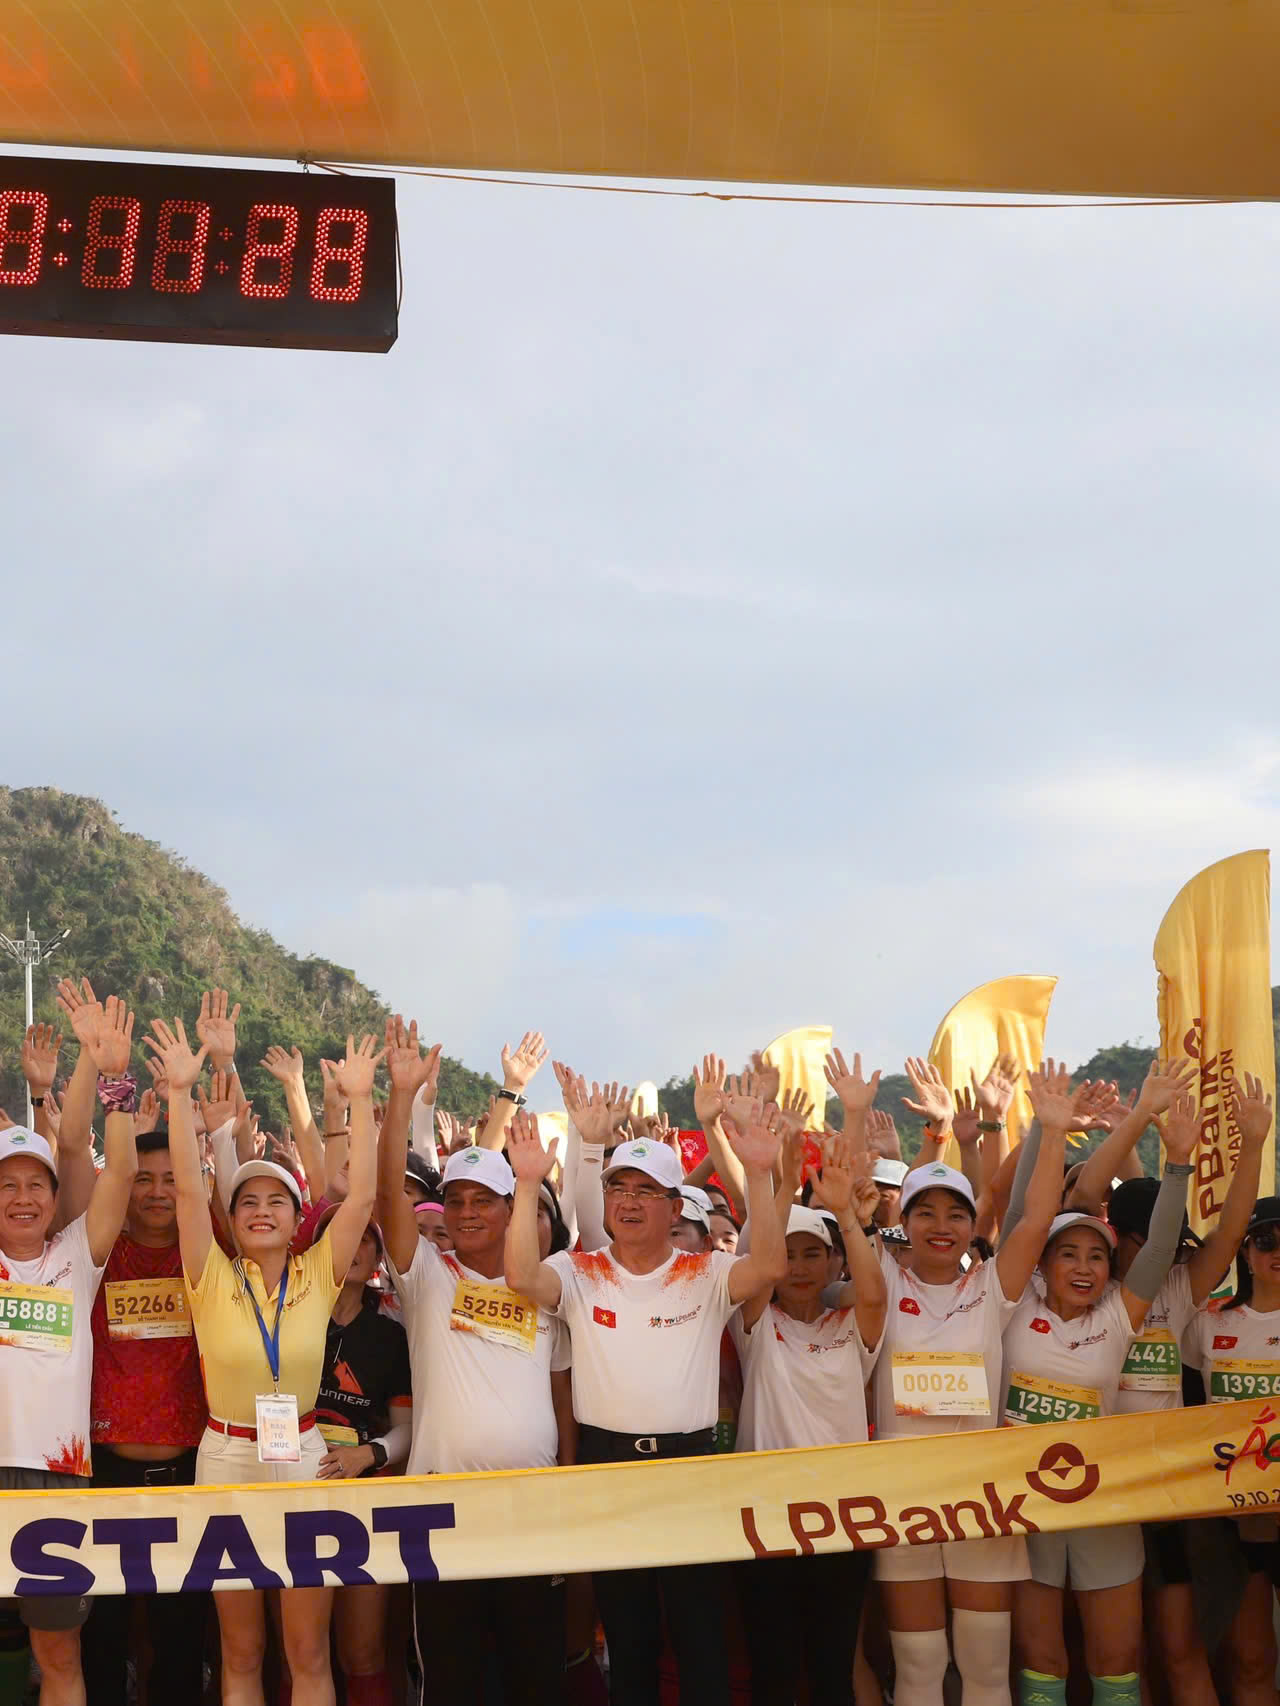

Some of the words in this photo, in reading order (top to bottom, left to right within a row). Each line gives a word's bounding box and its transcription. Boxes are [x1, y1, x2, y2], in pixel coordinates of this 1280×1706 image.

[1198, 1054, 1226, 1221] PBank
[114, 1294, 176, 1316] 52266
[463, 1295, 525, 1323] 52555
[1127, 1343, 1168, 1364] 442
[903, 1373, 970, 1393] 00026
[1222, 1374, 1280, 1396] 13936
[320, 1387, 372, 1408] UNNERS
[1018, 1391, 1082, 1422] 12552
[741, 1480, 1042, 1560] LPBank
[9, 1502, 457, 1598] START
